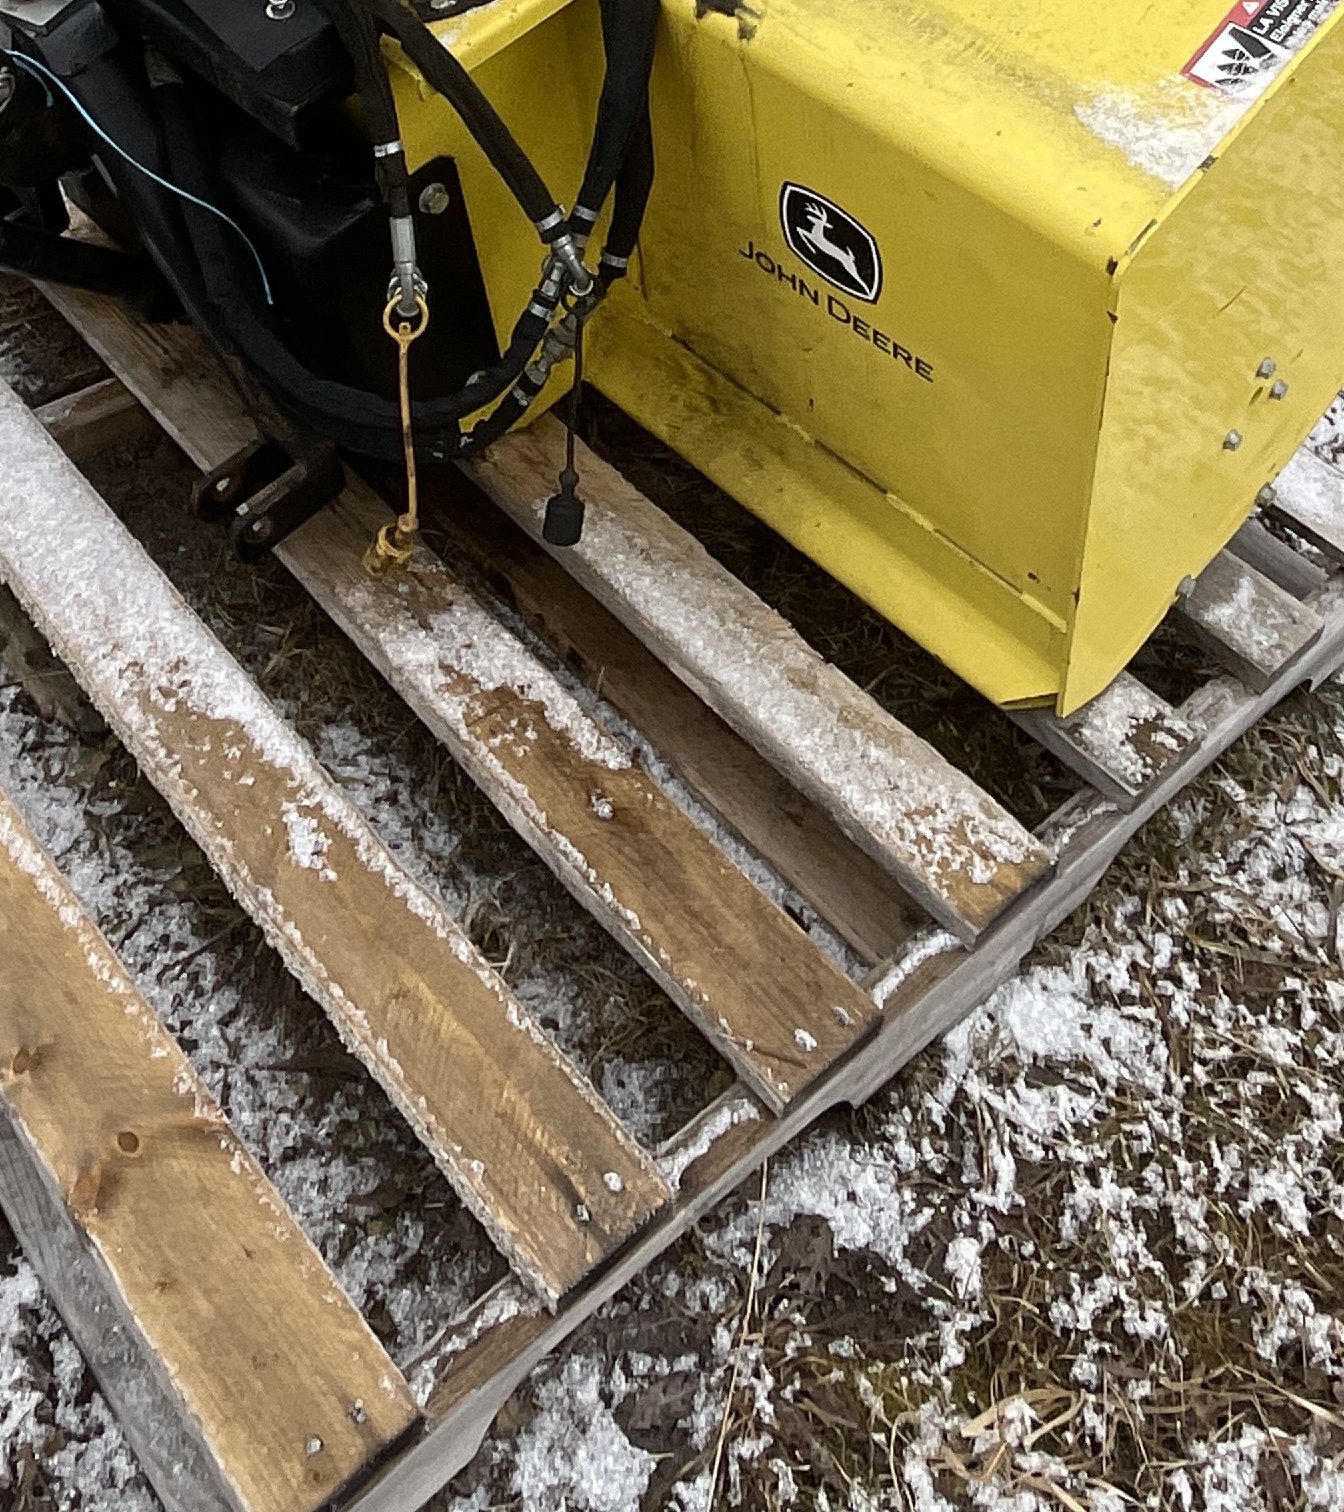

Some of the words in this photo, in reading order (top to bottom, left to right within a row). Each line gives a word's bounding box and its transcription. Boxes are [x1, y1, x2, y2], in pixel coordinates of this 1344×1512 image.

[1252, 16, 1274, 35] LA
[738, 240, 819, 306] JOHN
[827, 294, 934, 383] DEERE
